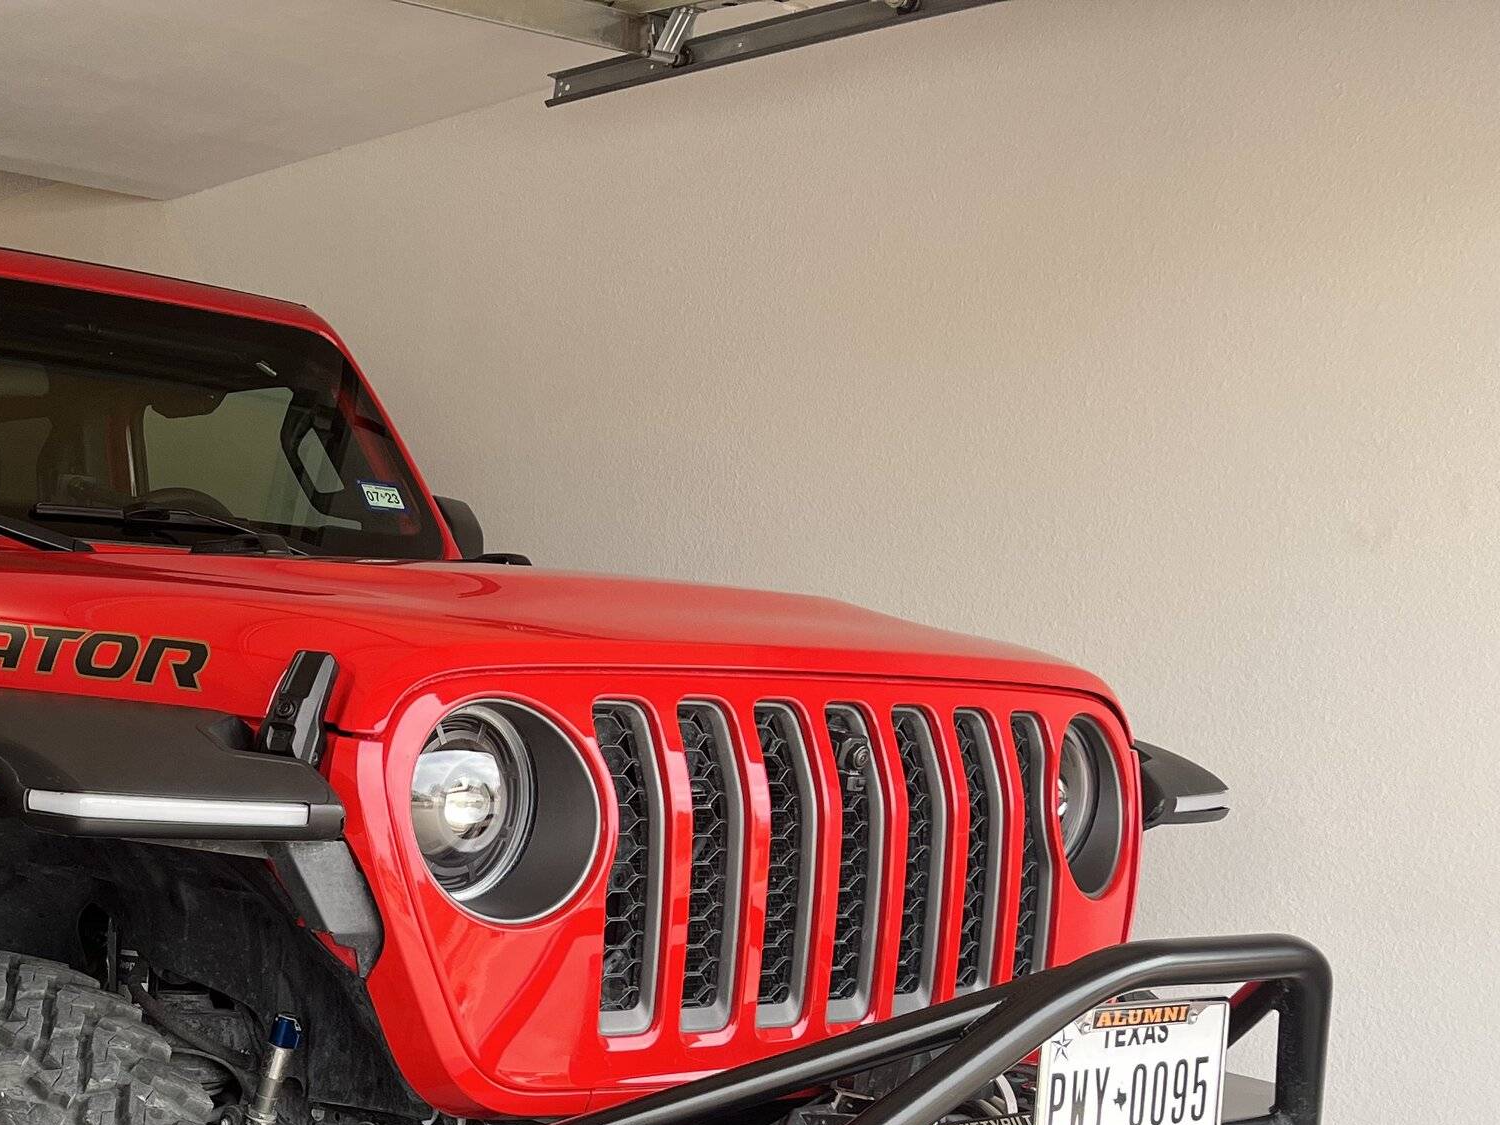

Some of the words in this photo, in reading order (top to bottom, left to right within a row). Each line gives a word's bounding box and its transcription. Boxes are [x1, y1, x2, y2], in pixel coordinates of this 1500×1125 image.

[366, 490, 379, 502] 07
[385, 492, 400, 504] 23
[1096, 1005, 1189, 1028] ALUMNI
[1105, 1024, 1169, 1049] TEXAS
